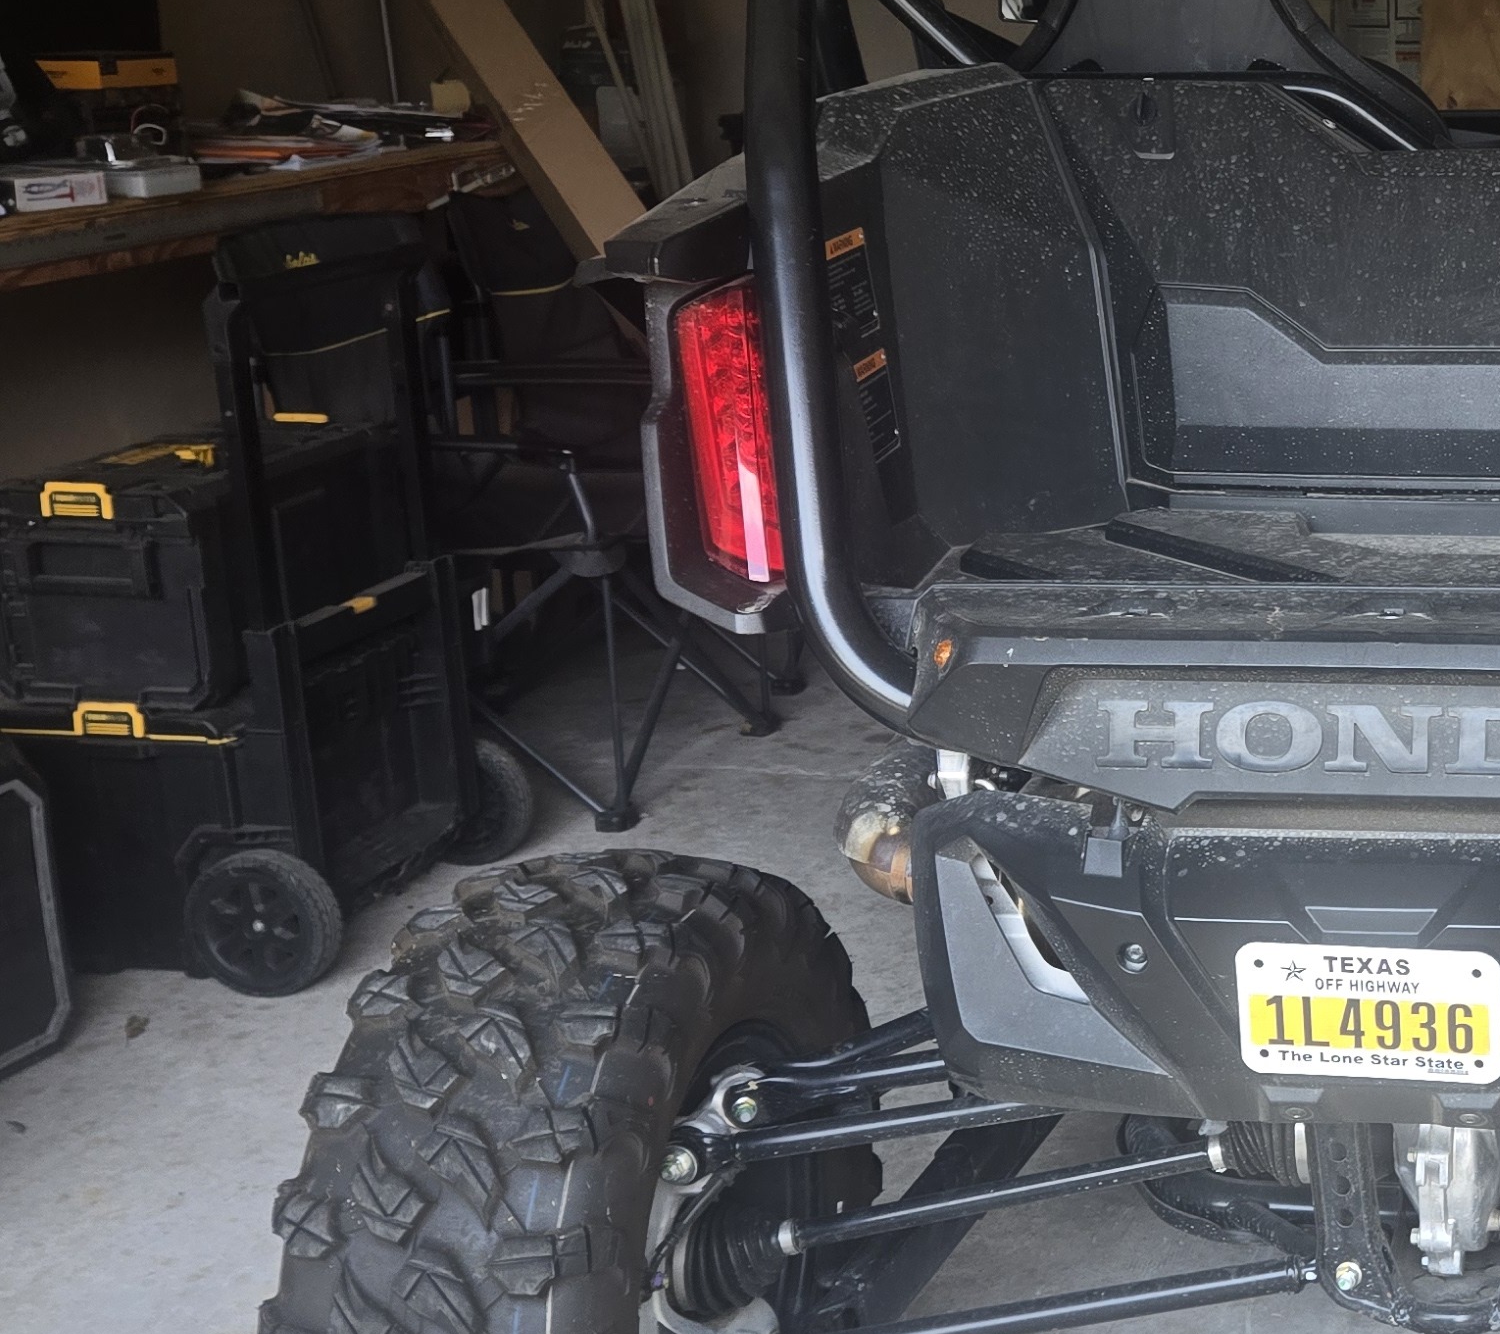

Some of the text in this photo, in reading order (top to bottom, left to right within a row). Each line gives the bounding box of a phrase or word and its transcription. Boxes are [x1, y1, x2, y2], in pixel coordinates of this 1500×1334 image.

[1323, 955, 1411, 976] TEXAS
[1315, 978, 1420, 994] OFF HIGHWAY
[1265, 995, 1473, 1054] 1L4936
[1278, 1049, 1464, 1070] The Lone Star State
